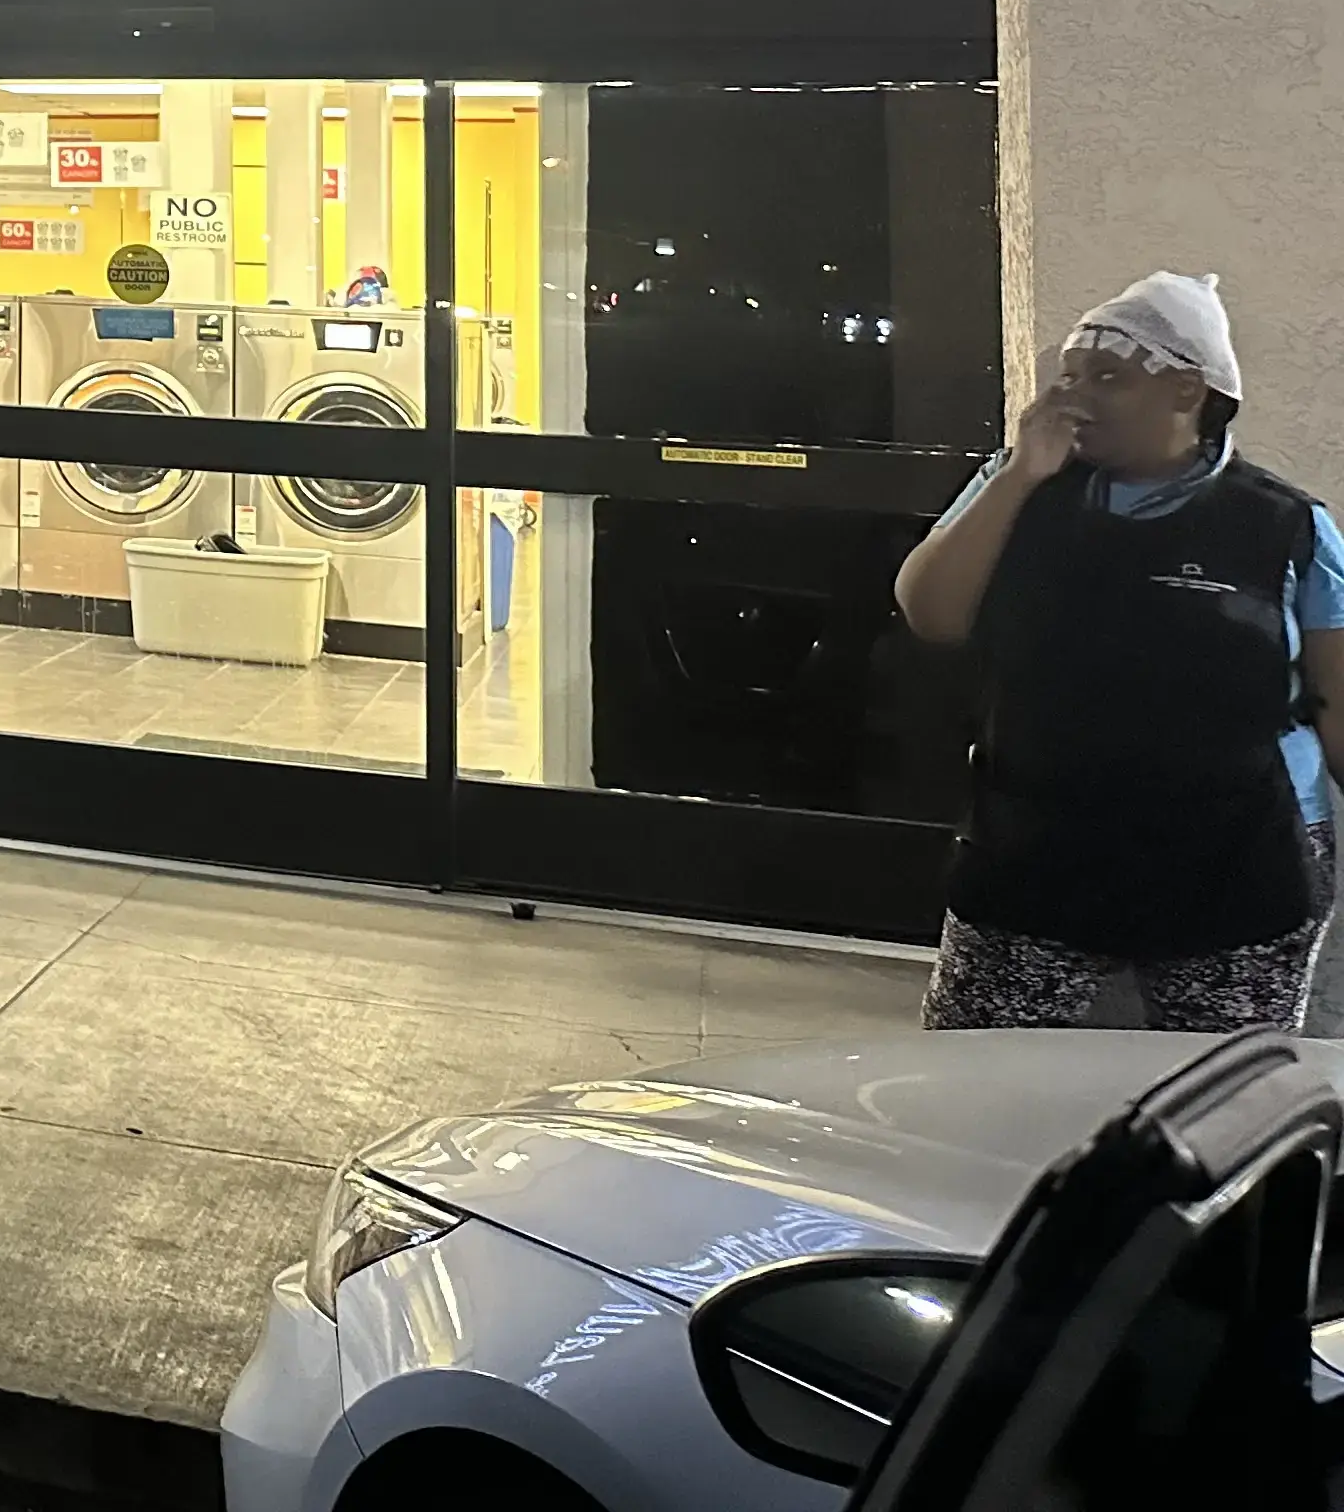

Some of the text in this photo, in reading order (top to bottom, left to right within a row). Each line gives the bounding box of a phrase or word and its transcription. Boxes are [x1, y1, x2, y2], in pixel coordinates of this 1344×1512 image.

[166, 197, 217, 218] NO
[159, 219, 224, 233] PUBLIC
[156, 231, 227, 243] RESTROOM
[111, 259, 167, 268] AUTOMATIC
[109, 270, 168, 282] CAUTION
[714, 451, 739, 462] DOOR
[775, 454, 804, 465] CLEAR
